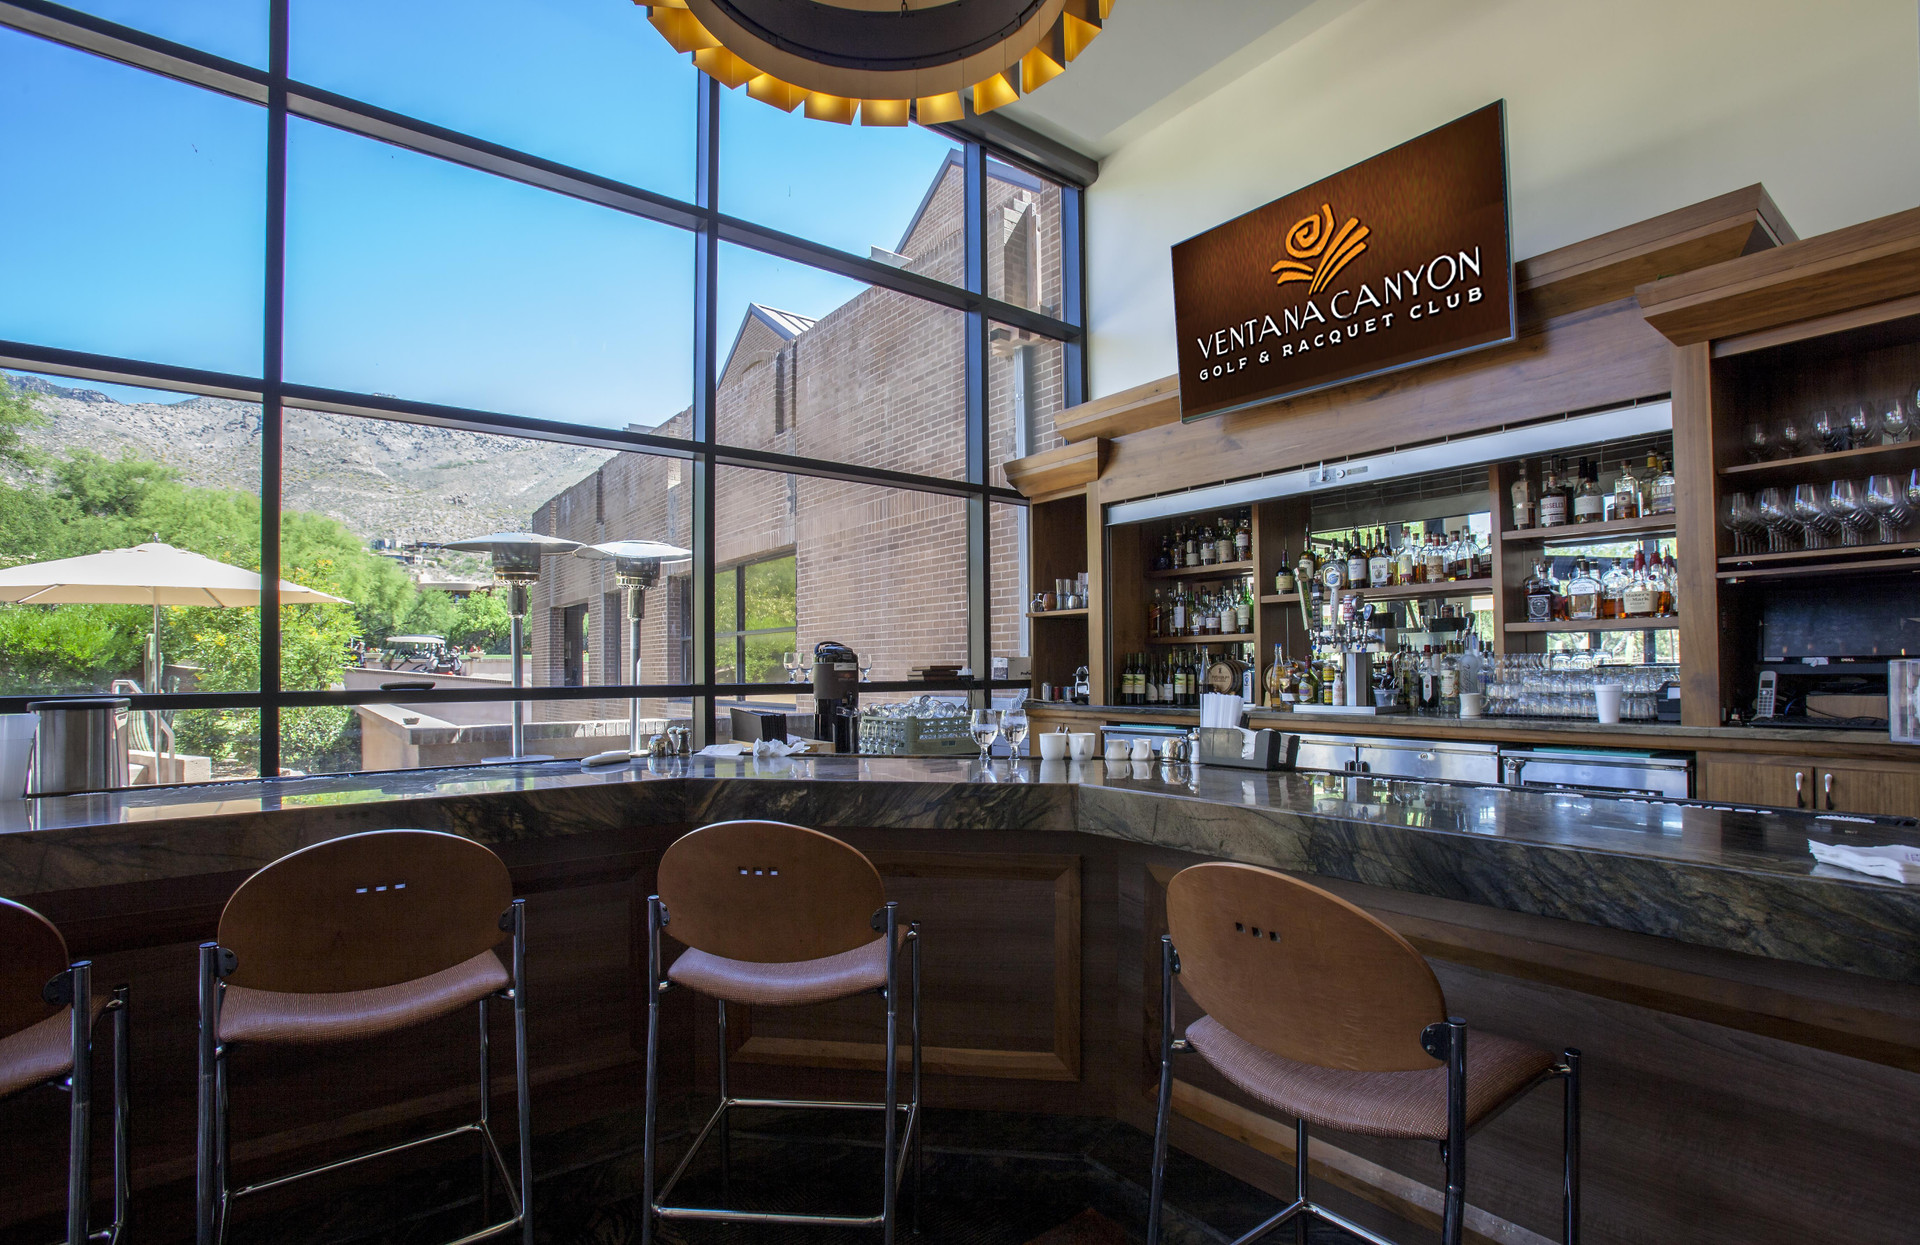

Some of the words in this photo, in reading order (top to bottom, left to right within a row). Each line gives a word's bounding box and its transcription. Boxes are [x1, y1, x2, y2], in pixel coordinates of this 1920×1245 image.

[1197, 300, 1325, 359] VENTANA
[1330, 246, 1481, 319] CANYON
[1199, 357, 1248, 381] GOLF
[1259, 350, 1270, 364] &
[1282, 313, 1394, 357] RACQUET
[1409, 286, 1483, 319] CLUB
